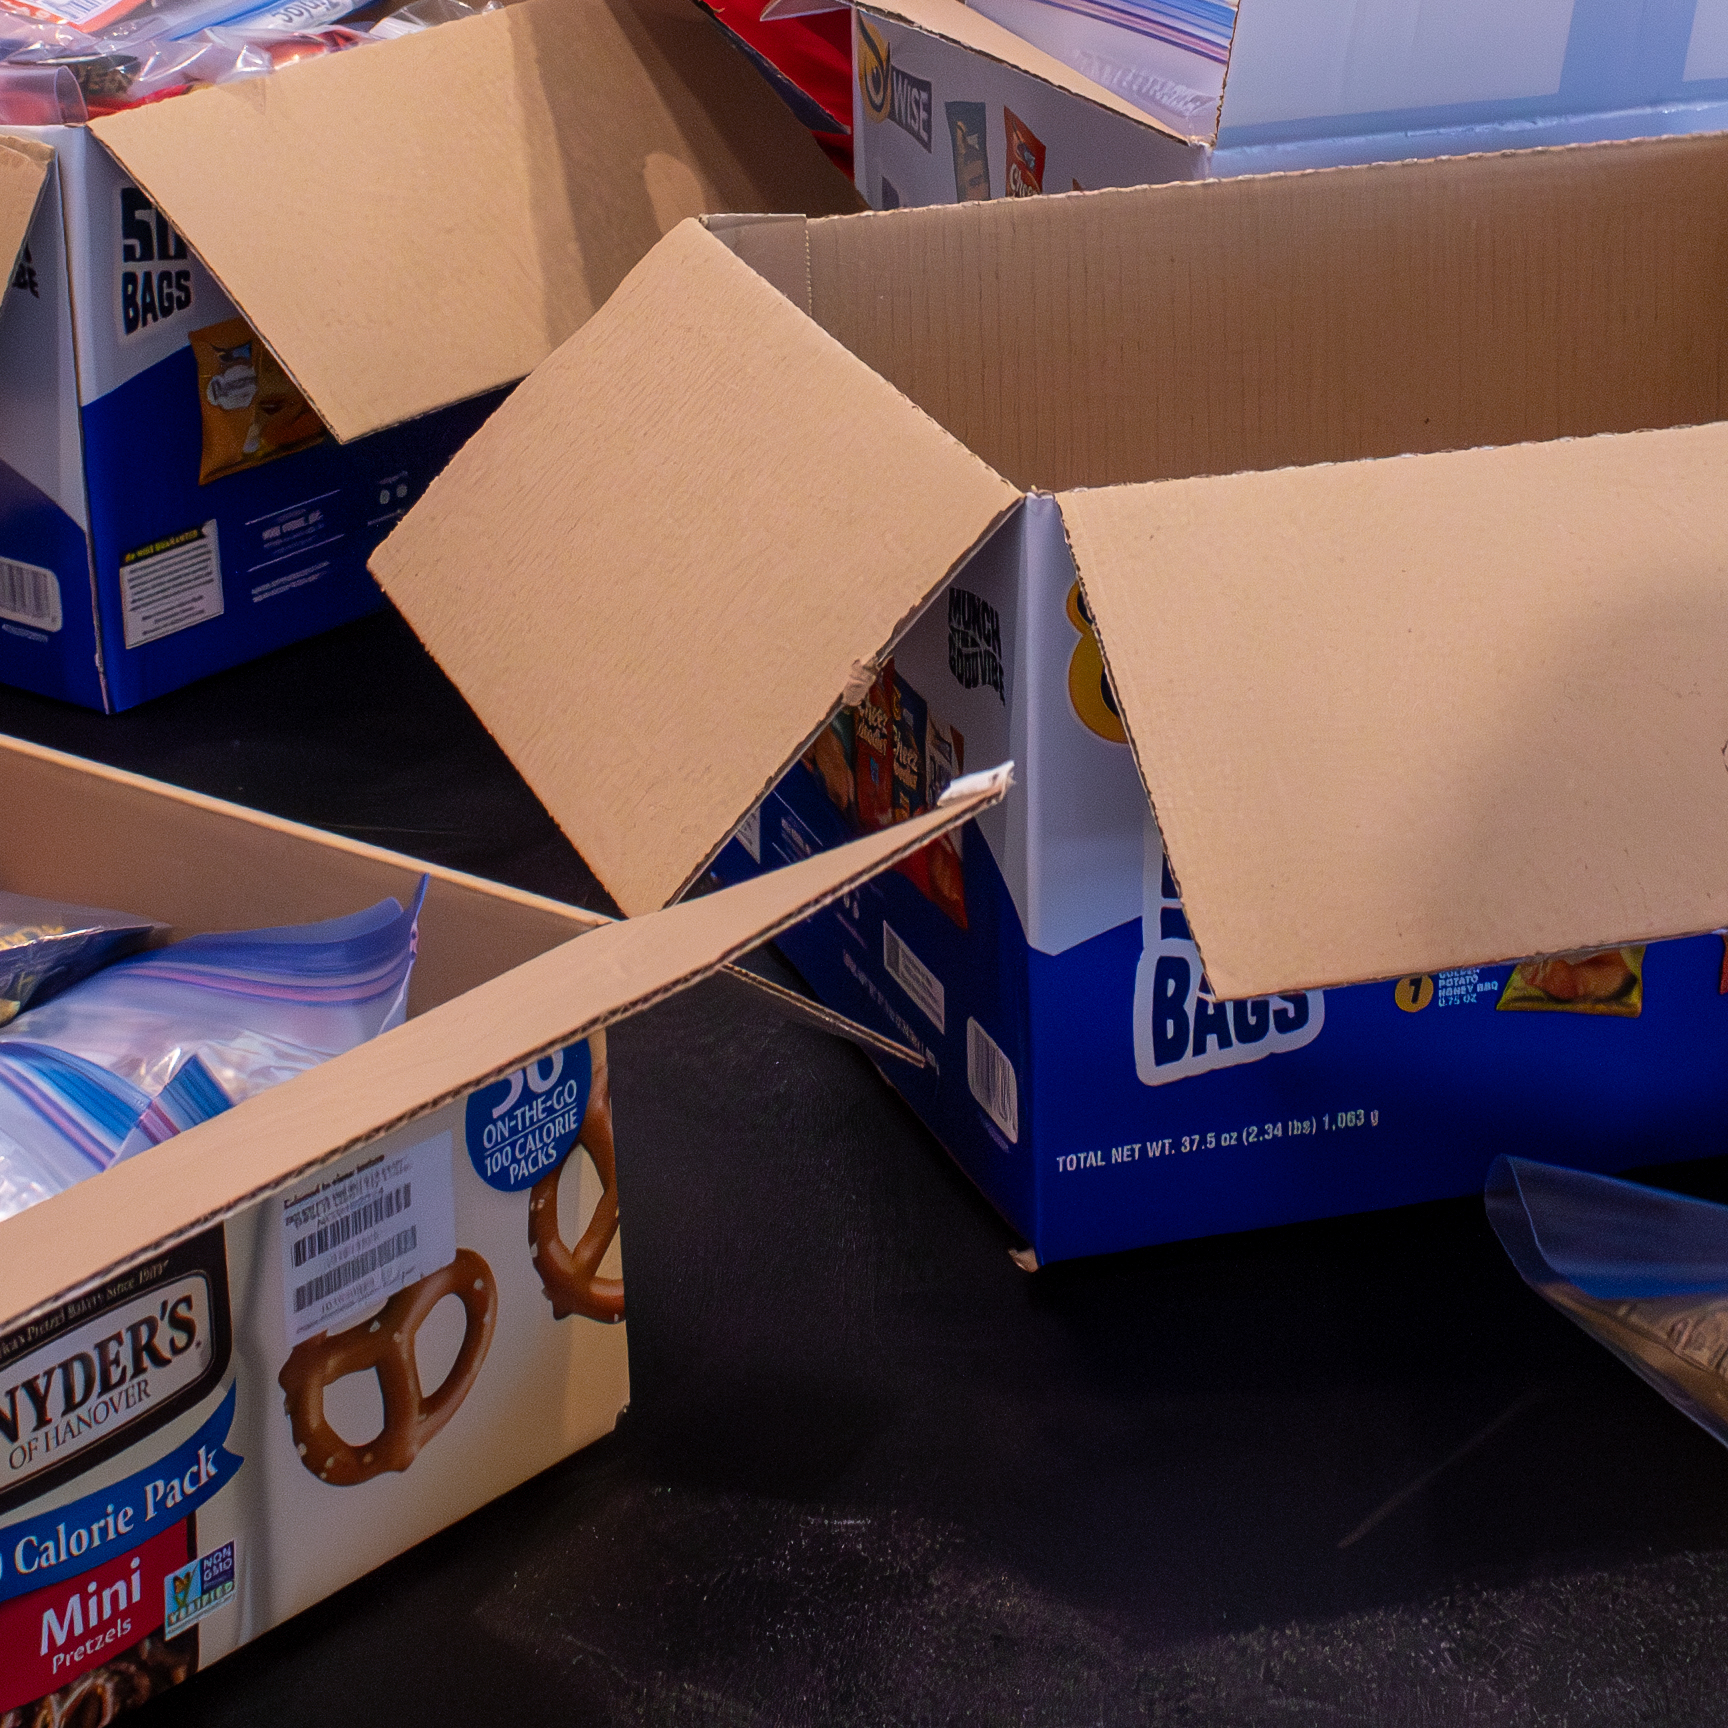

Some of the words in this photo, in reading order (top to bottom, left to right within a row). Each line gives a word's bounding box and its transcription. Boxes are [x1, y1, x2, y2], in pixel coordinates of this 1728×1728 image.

[893, 70, 929, 144] WISE
[122, 270, 193, 337] BAGS
[1151, 954, 1310, 1068] BAGS
[1409, 976, 1423, 1005] 7
[1438, 974, 1479, 989] POTATO
[1438, 984, 1475, 998] HONEY
[483, 1079, 578, 1149] ON-THE-GO
[484, 1145, 512, 1177] 100
[515, 1107, 578, 1160] CALORIE
[1056, 1151, 1106, 1173] TOTAL
[1110, 1143, 1142, 1165] NET
[1146, 1137, 1176, 1159] WT.
[1180, 1131, 1217, 1154] 37.5
[1220, 1132, 1238, 1147] oz
[1242, 1123, 1284, 1147] (2.34
[1288, 1115, 1318, 1138] lbs)
[1322, 1108, 1365, 1132] 1,063
[509, 1141, 557, 1185] PACKS
[9, 1437, 39, 1470] OF
[43, 1379, 153, 1447] HANOVER
[14, 1503, 135, 1575] Calorie
[144, 1444, 219, 1522] Pack
[203, 1545, 232, 1571] NON
[203, 1558, 233, 1581] GMO
[39, 1556, 142, 1658] Mini
[51, 1616, 132, 1675] Pretzels
